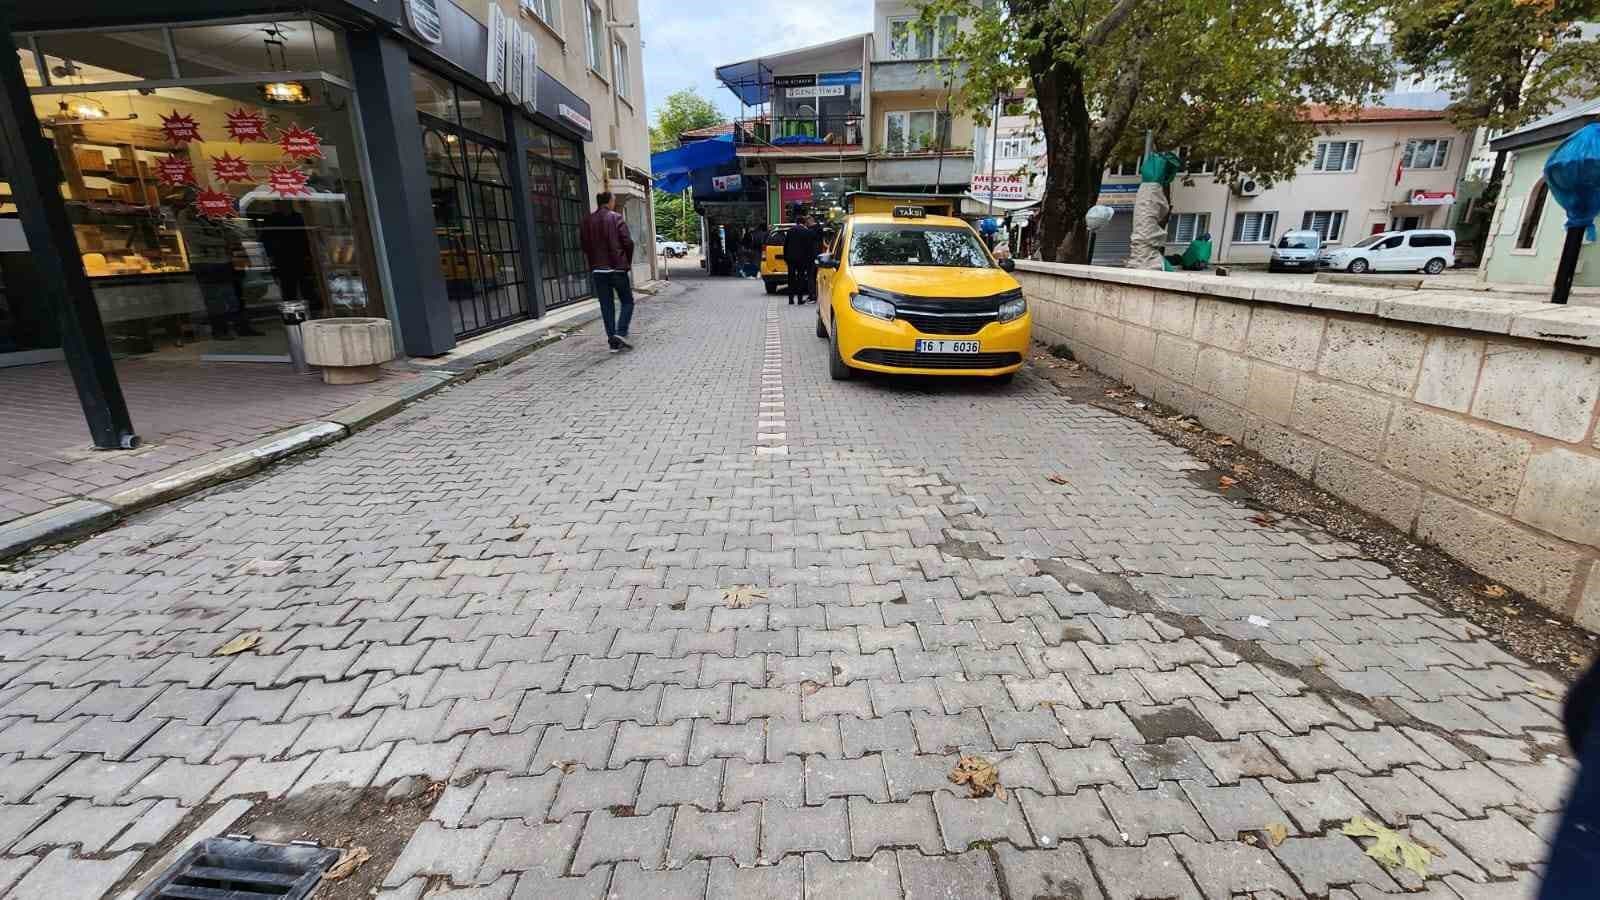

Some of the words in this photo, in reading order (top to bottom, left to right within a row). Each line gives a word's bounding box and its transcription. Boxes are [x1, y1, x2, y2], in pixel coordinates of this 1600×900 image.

[923, 341, 933, 352] 16
[939, 341, 944, 352] T
[953, 342, 978, 352] 6036
